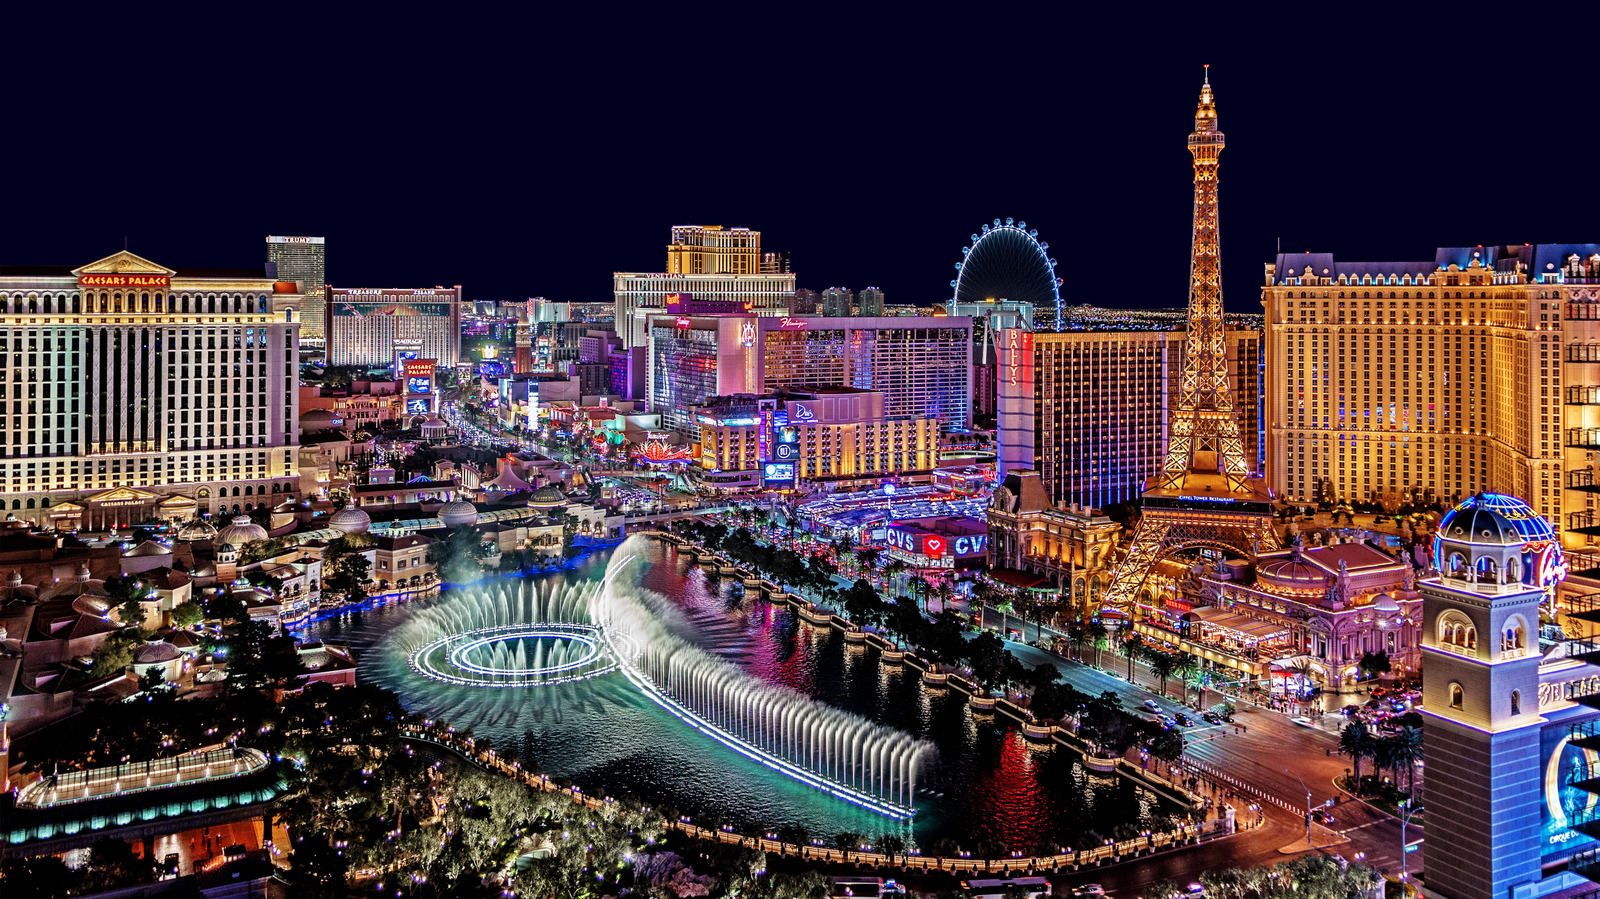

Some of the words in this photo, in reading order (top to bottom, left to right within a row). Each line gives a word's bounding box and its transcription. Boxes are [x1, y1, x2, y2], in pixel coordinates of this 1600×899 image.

[81, 277, 126, 285] CAESARS
[128, 277, 168, 285] PALACE
[780, 317, 808, 328] Flamingo
[887, 528, 915, 552] CVS
[1549, 831, 1571, 844] CIRQUE
